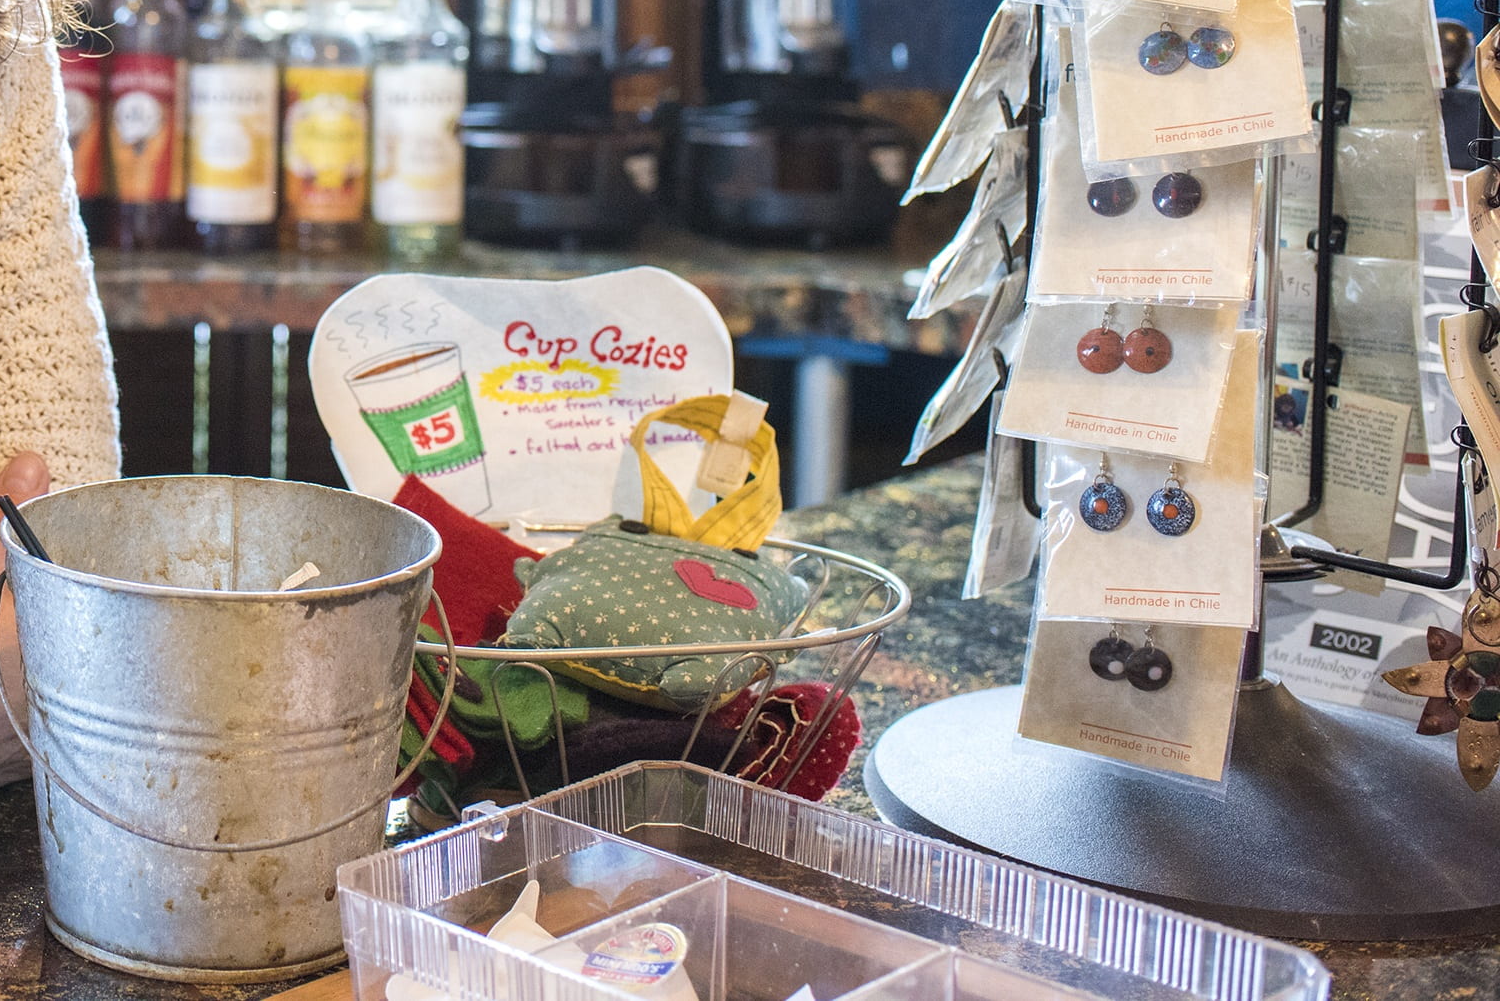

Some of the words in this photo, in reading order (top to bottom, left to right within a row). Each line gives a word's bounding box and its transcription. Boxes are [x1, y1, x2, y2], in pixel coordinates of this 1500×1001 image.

[1155, 126, 1223, 144] Handmade
[1228, 124, 1239, 134] in
[1243, 119, 1275, 132] Chile
[1096, 274, 1162, 285] Handmade
[1166, 275, 1178, 285] in
[1181, 275, 1213, 285] Chile
[504, 320, 578, 370] Cup
[590, 325, 688, 371] Cozies
[516, 374, 544, 392] $5
[552, 376, 594, 391] each
[609, 393, 676, 412] recycled
[411, 411, 455, 450] $5
[1065, 418, 1128, 436] Handmade
[1132, 428, 1143, 438] in
[1147, 430, 1177, 443] Chile
[1104, 594, 1170, 607] Handmade
[1174, 597, 1185, 608] in
[1189, 597, 1221, 610] Chile
[1320, 628, 1374, 655] 2002
[1267, 649, 1289, 662] An
[1290, 653, 1361, 680] Anthology
[1079, 729, 1142, 752] Handmade
[1146, 744, 1157, 755] in
[1161, 747, 1191, 762] Chile
